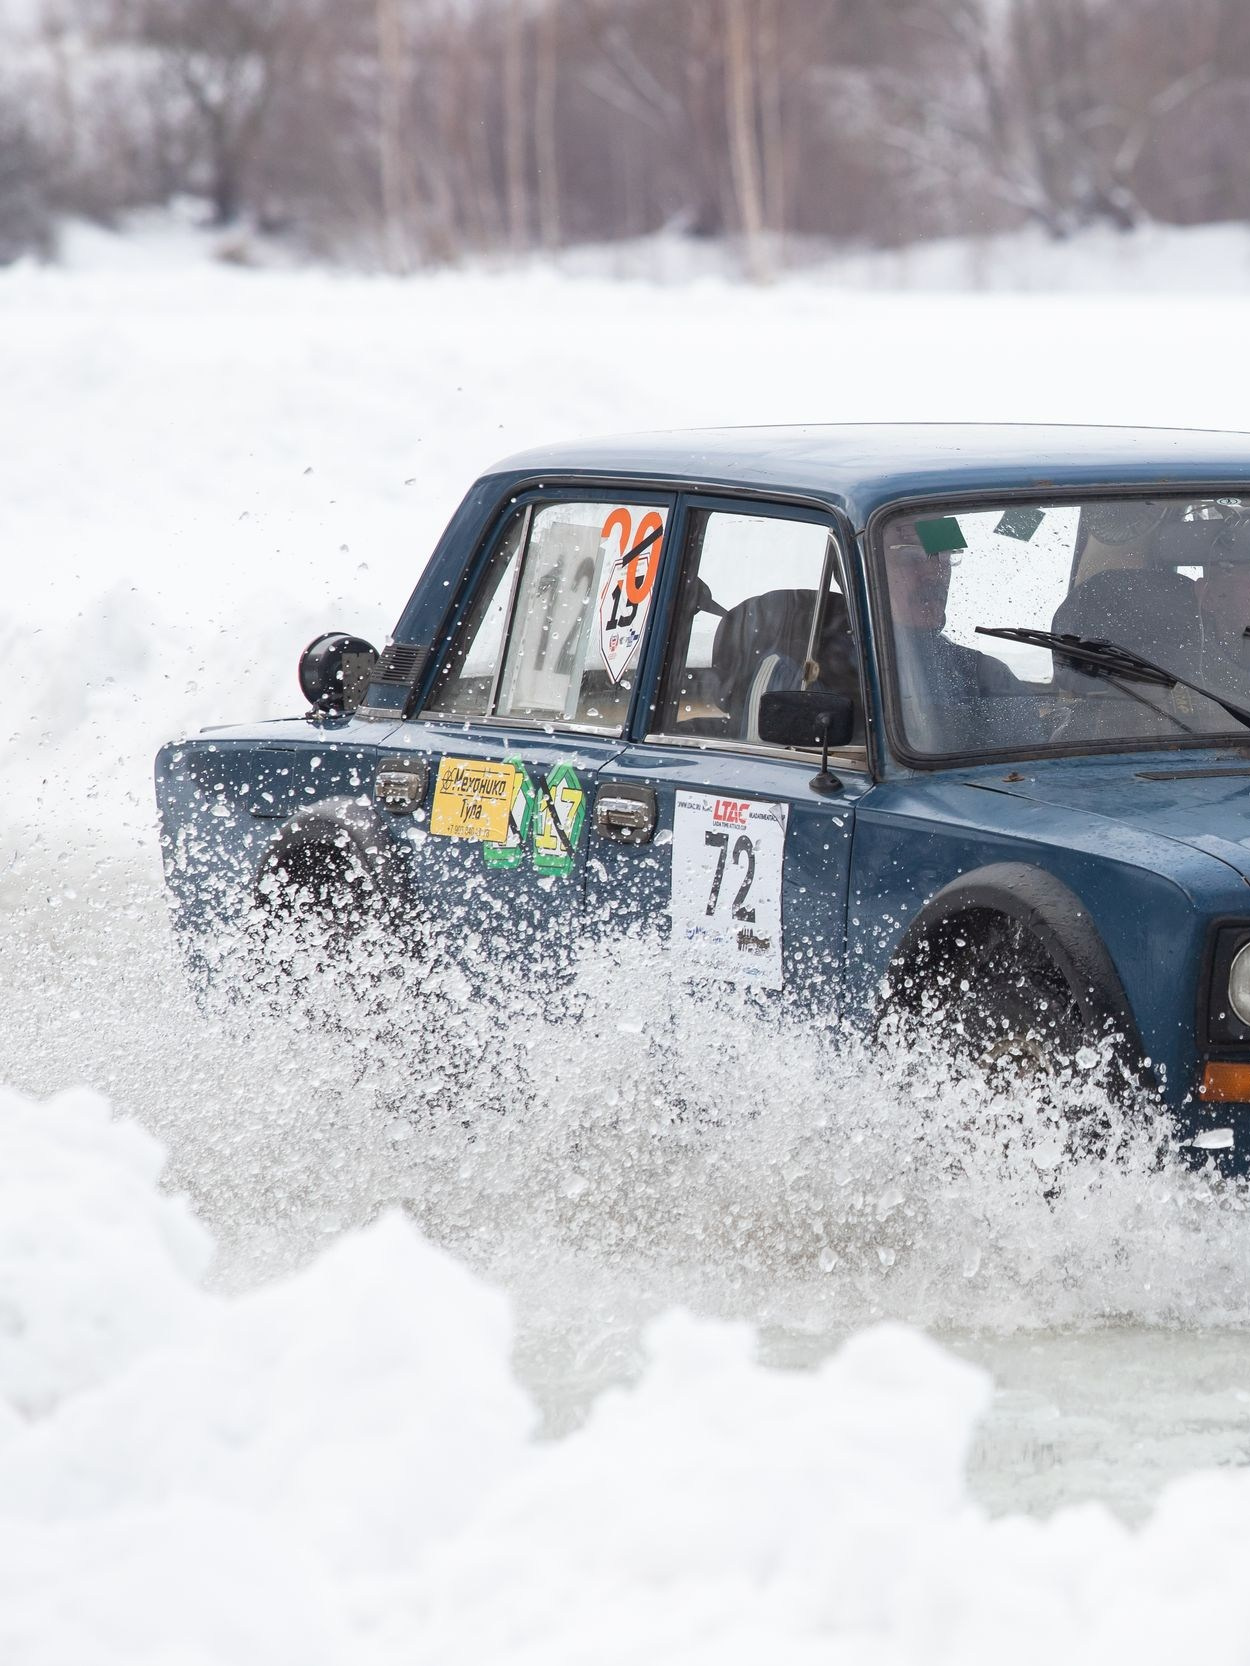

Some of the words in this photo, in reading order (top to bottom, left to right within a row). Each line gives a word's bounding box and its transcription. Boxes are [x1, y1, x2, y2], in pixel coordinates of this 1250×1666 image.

[460, 799, 483, 823] Тула
[713, 799, 750, 824] LTAC
[705, 830, 756, 923] 72
